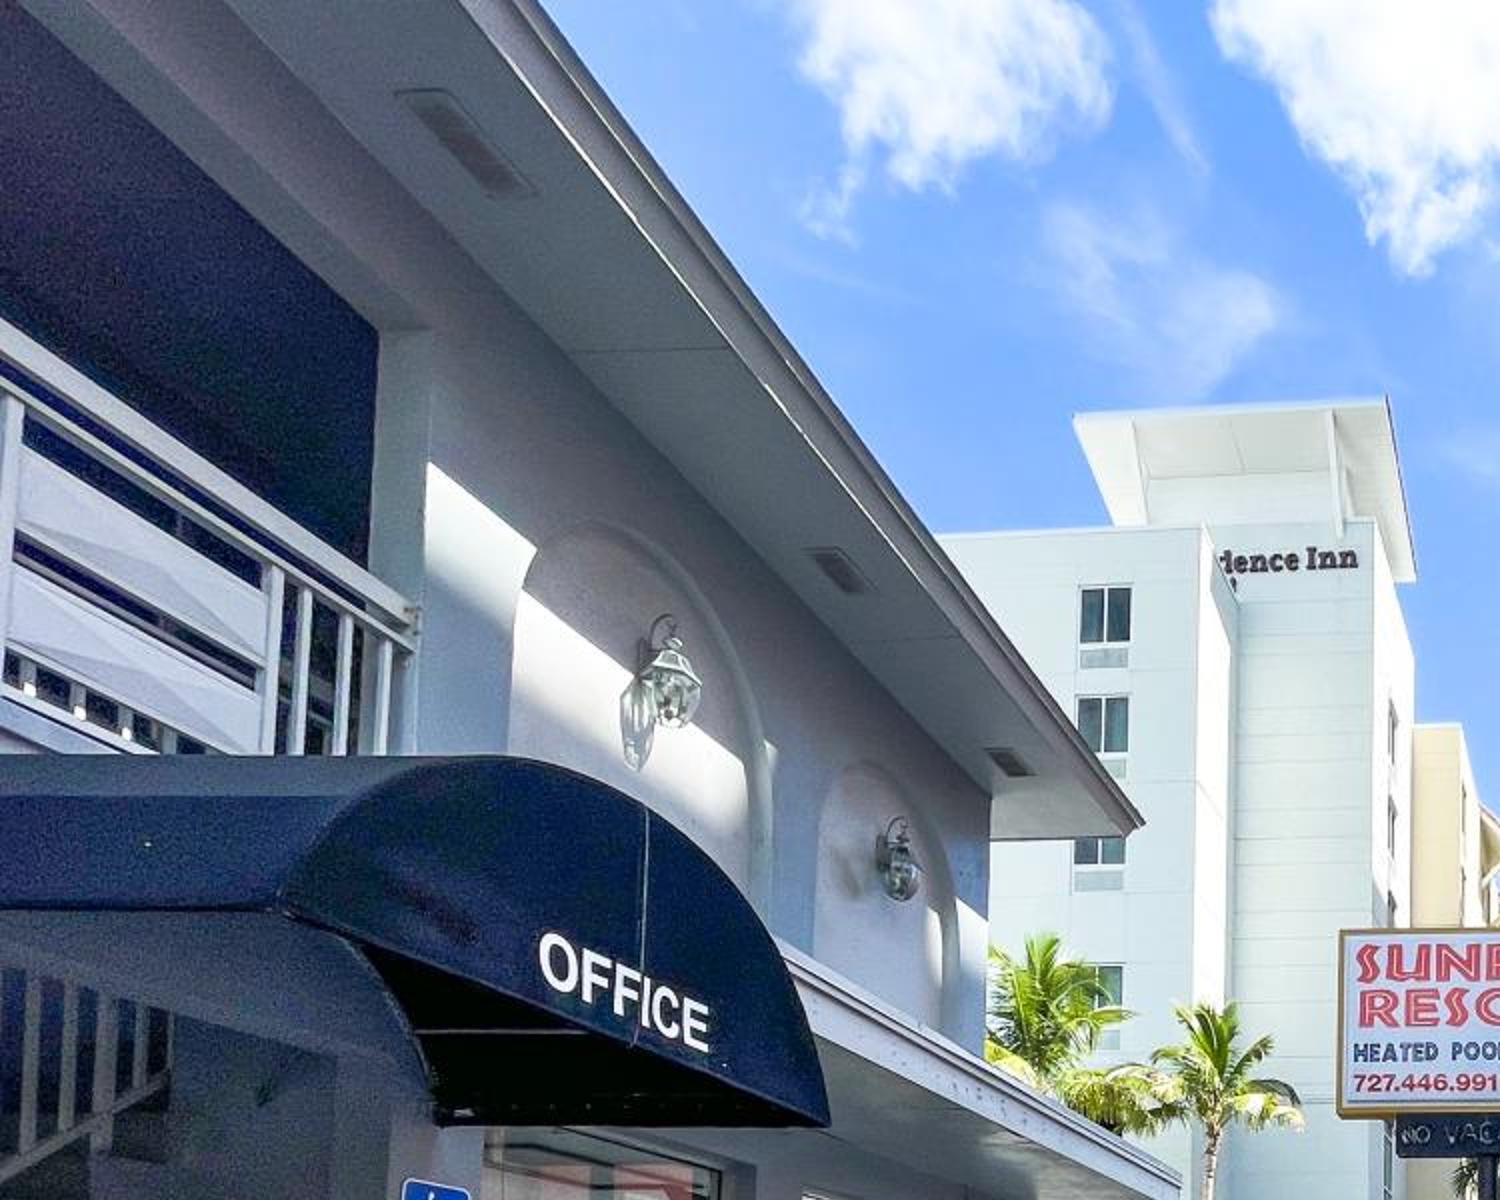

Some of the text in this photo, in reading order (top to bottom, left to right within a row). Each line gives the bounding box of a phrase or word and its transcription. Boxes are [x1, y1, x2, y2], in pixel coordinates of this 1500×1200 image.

[1306, 546, 1359, 570] Inn
[539, 932, 709, 1053] OFFICE
[1353, 1041, 1439, 1063] HEATED
[1400, 1124, 1431, 1145] NO
